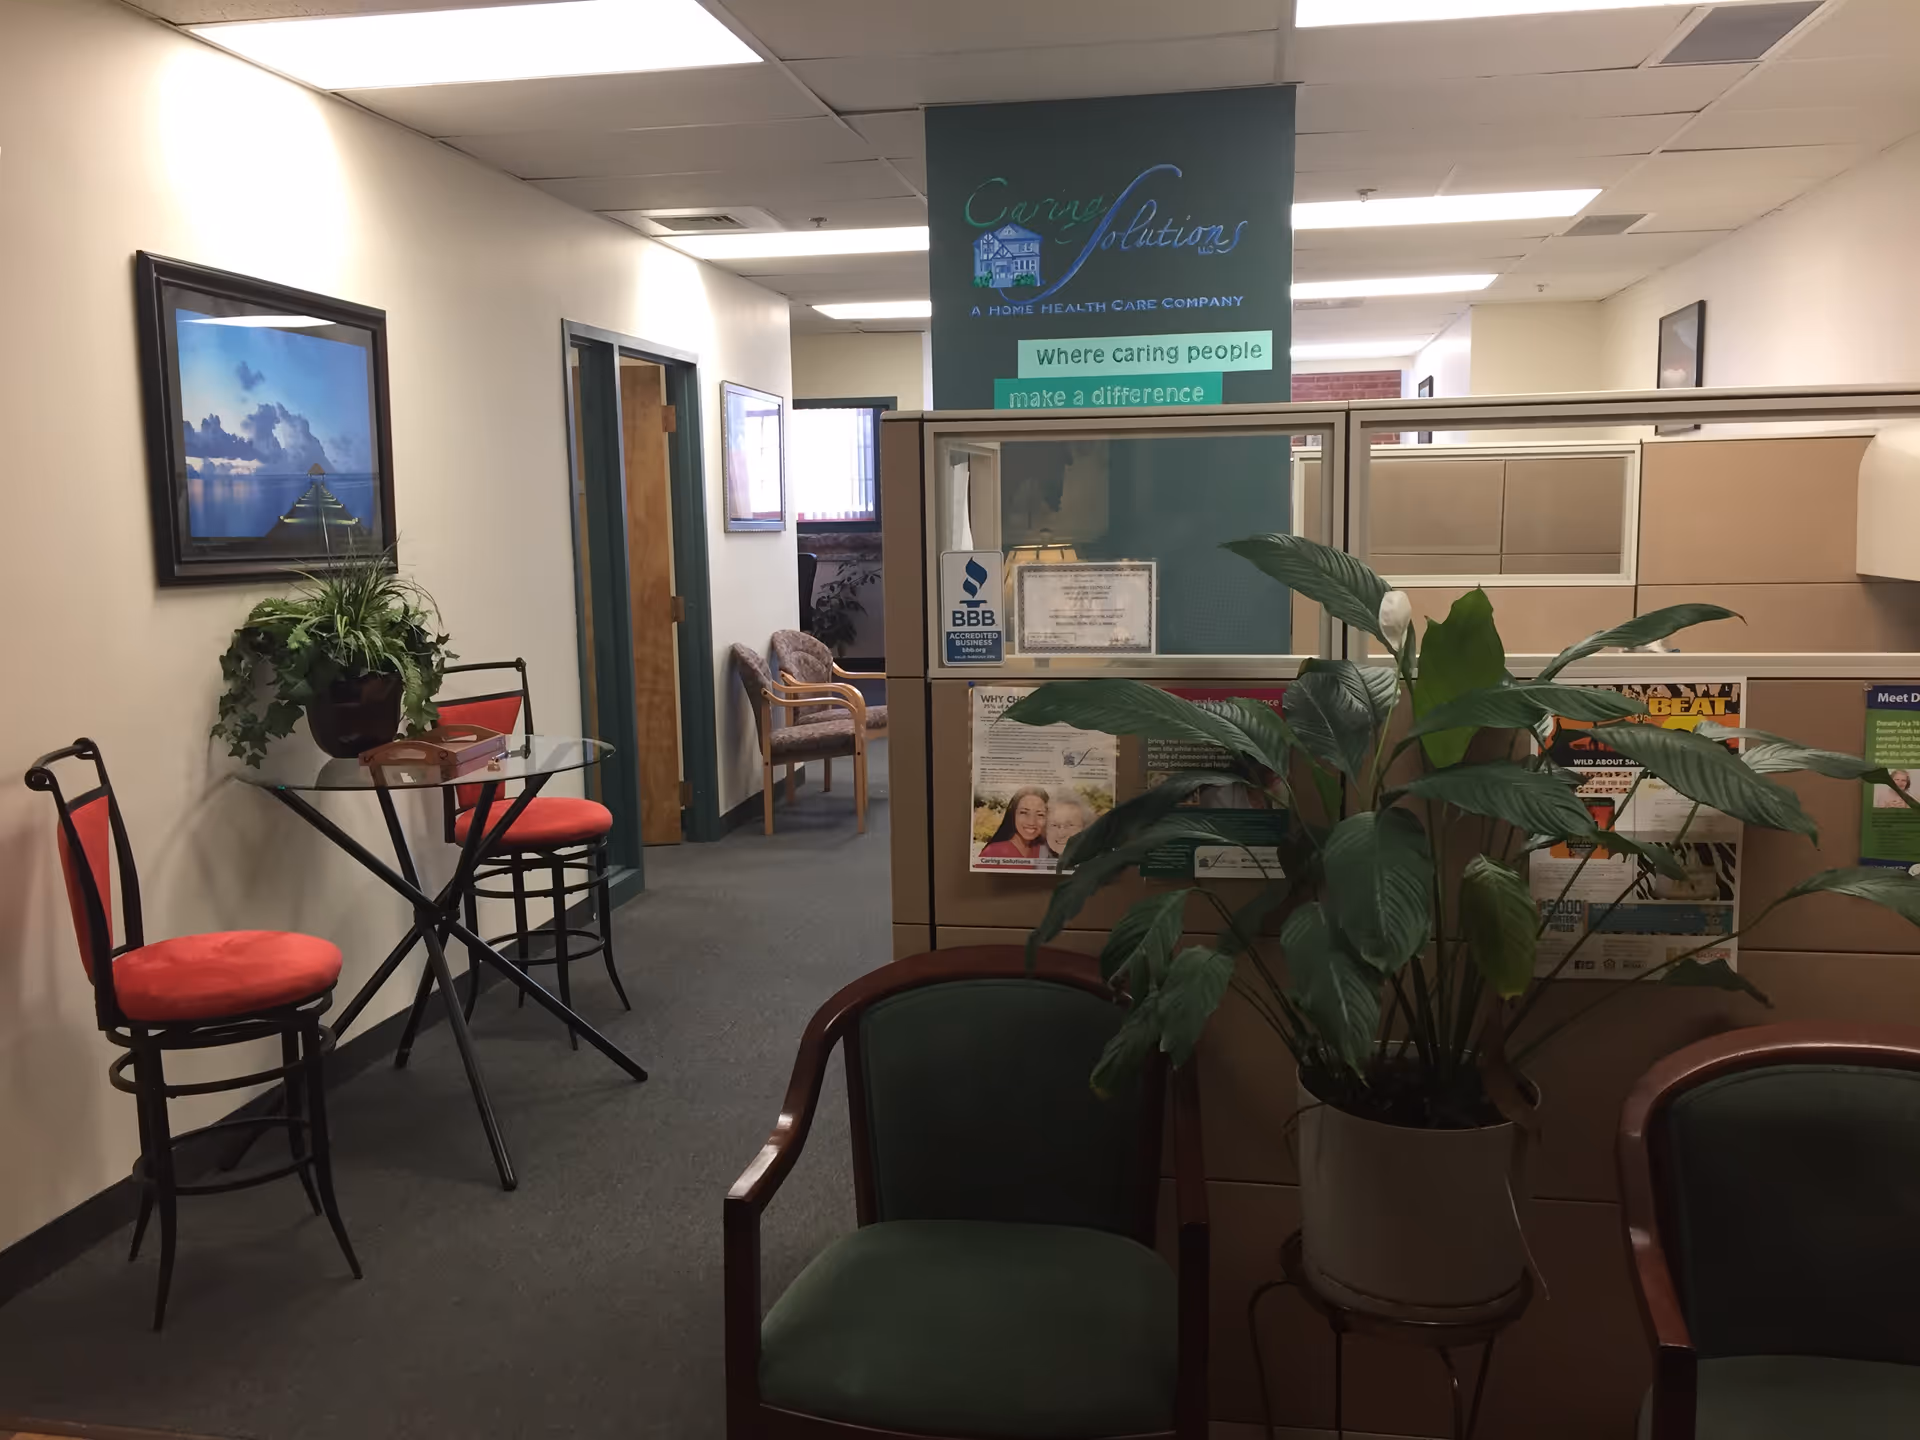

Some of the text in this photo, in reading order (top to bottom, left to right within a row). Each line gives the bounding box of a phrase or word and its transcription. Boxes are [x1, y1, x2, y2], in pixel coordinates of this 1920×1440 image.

[965, 178, 1106, 245] Caring
[970, 296, 1244, 317] A HOME HEALTH CARE COMPANY
[1112, 344, 1179, 365] caring
[1187, 340, 1263, 364] people
[1008, 384, 1205, 409] make a difference
[951, 610, 996, 626] BBB
[949, 632, 999, 640] ACCREDITED
[955, 639, 993, 647] BUSINESS
[979, 694, 1005, 704] WHY
[1877, 692, 1920, 703] Meet D
[1648, 696, 1732, 716] BEAT
[1573, 758, 1594, 766] WILD
